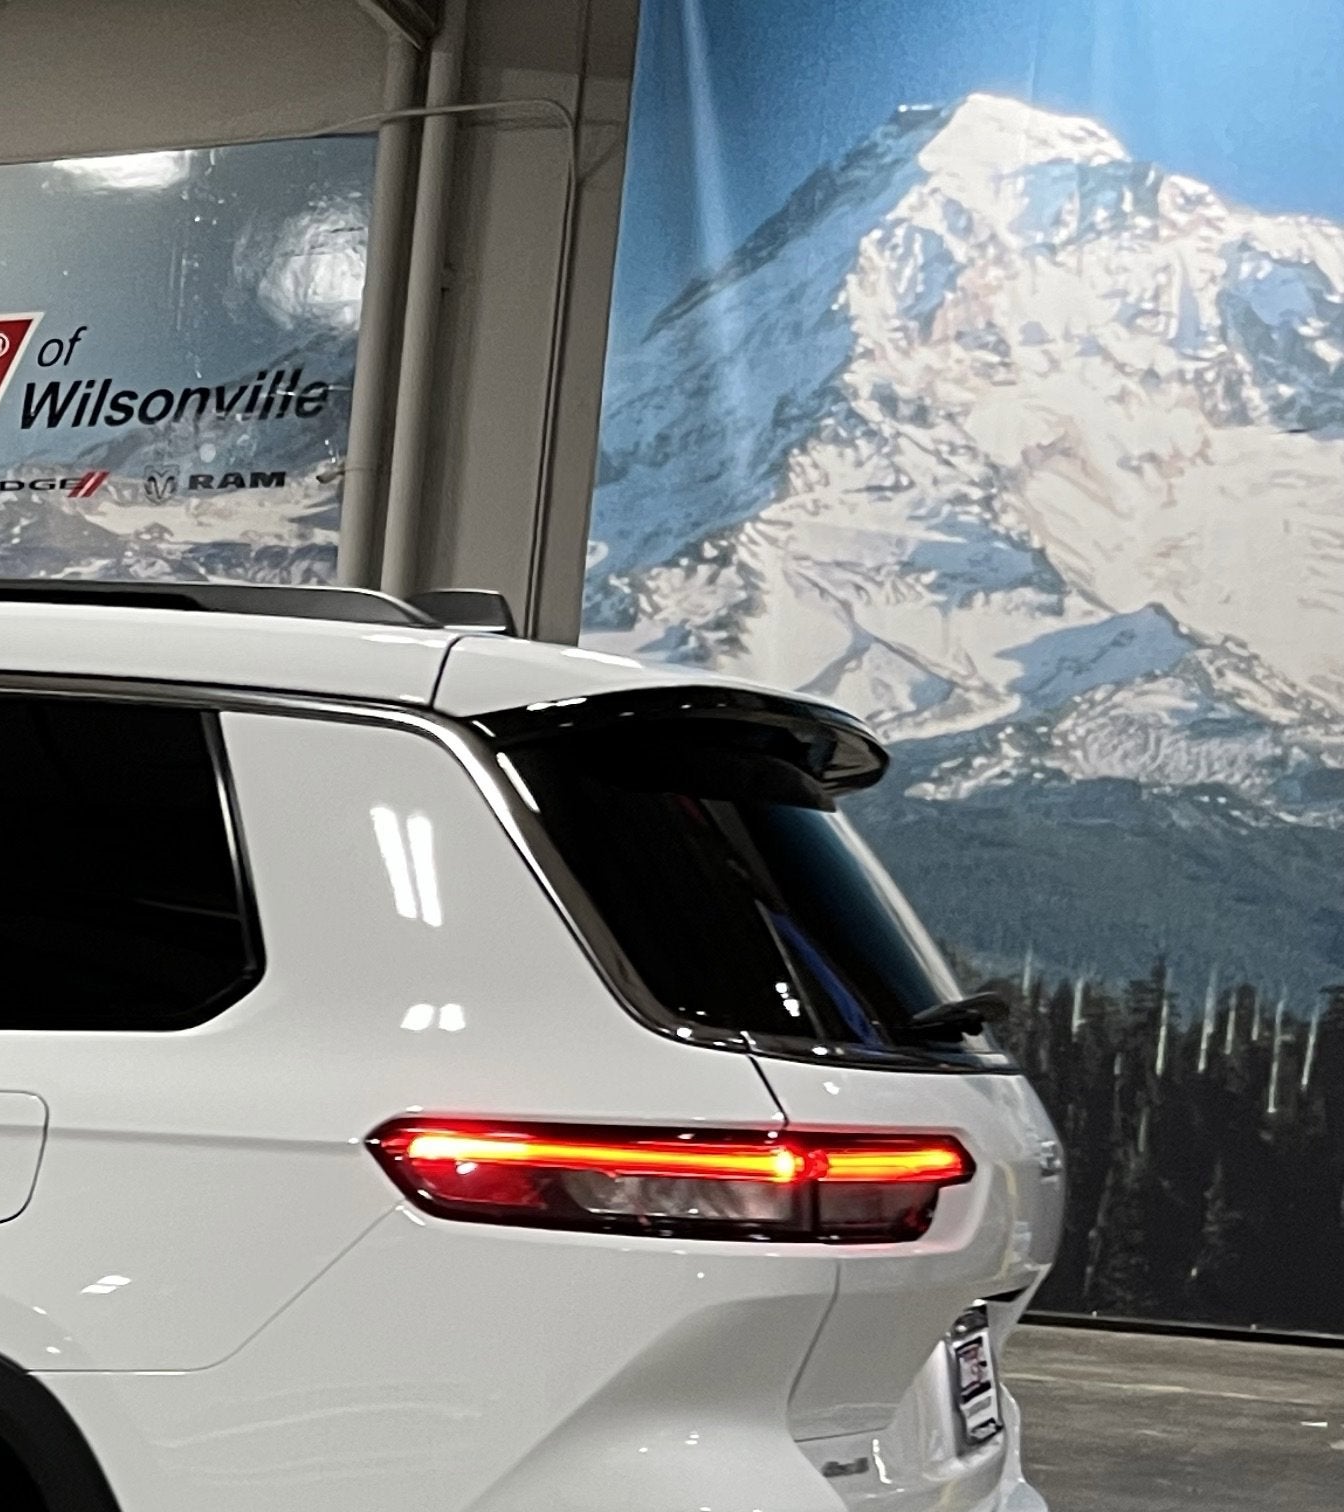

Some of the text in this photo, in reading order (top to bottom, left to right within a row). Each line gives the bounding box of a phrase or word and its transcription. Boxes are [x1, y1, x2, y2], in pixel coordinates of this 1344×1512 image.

[37, 326, 88, 367] of
[20, 368, 331, 430] Wilsonville
[188, 471, 287, 491] RAM
